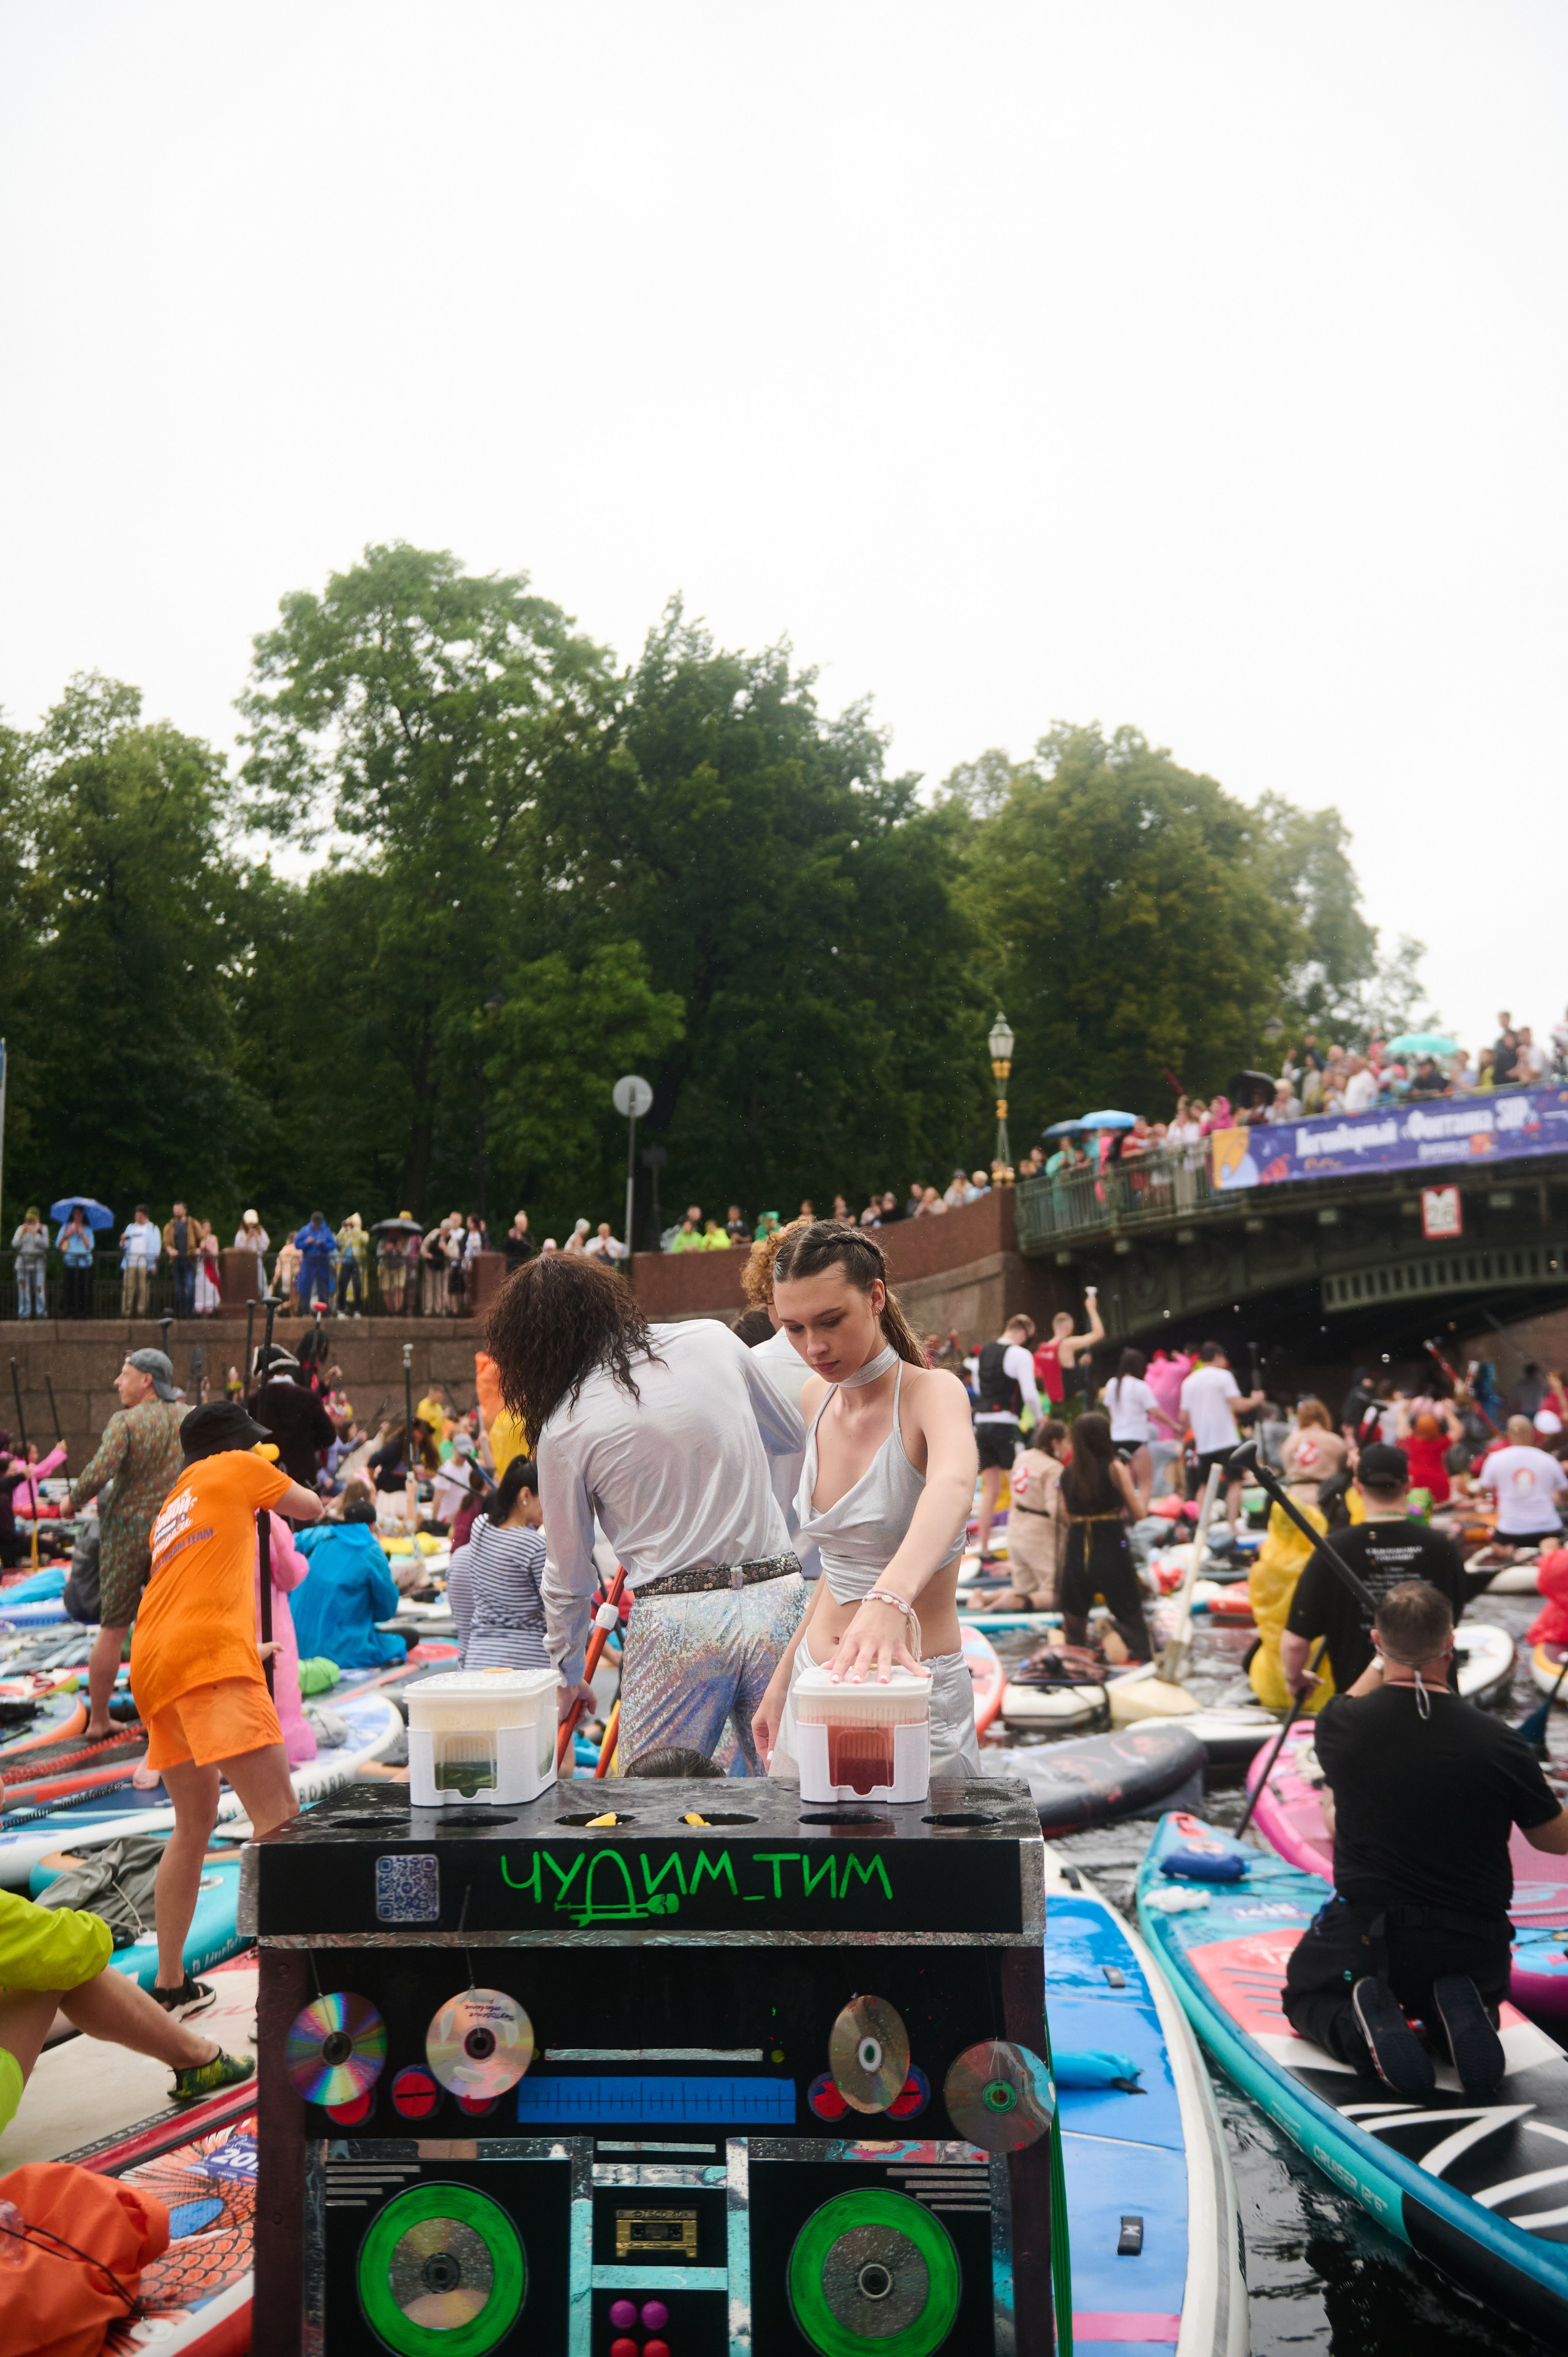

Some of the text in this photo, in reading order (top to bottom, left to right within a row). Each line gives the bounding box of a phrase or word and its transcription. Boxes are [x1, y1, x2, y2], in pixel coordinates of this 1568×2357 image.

[186, 1527, 213, 1545] TEAM
[111, 2108, 179, 2139] MARINA
[1313, 2143, 1358, 2192] CRUISER
